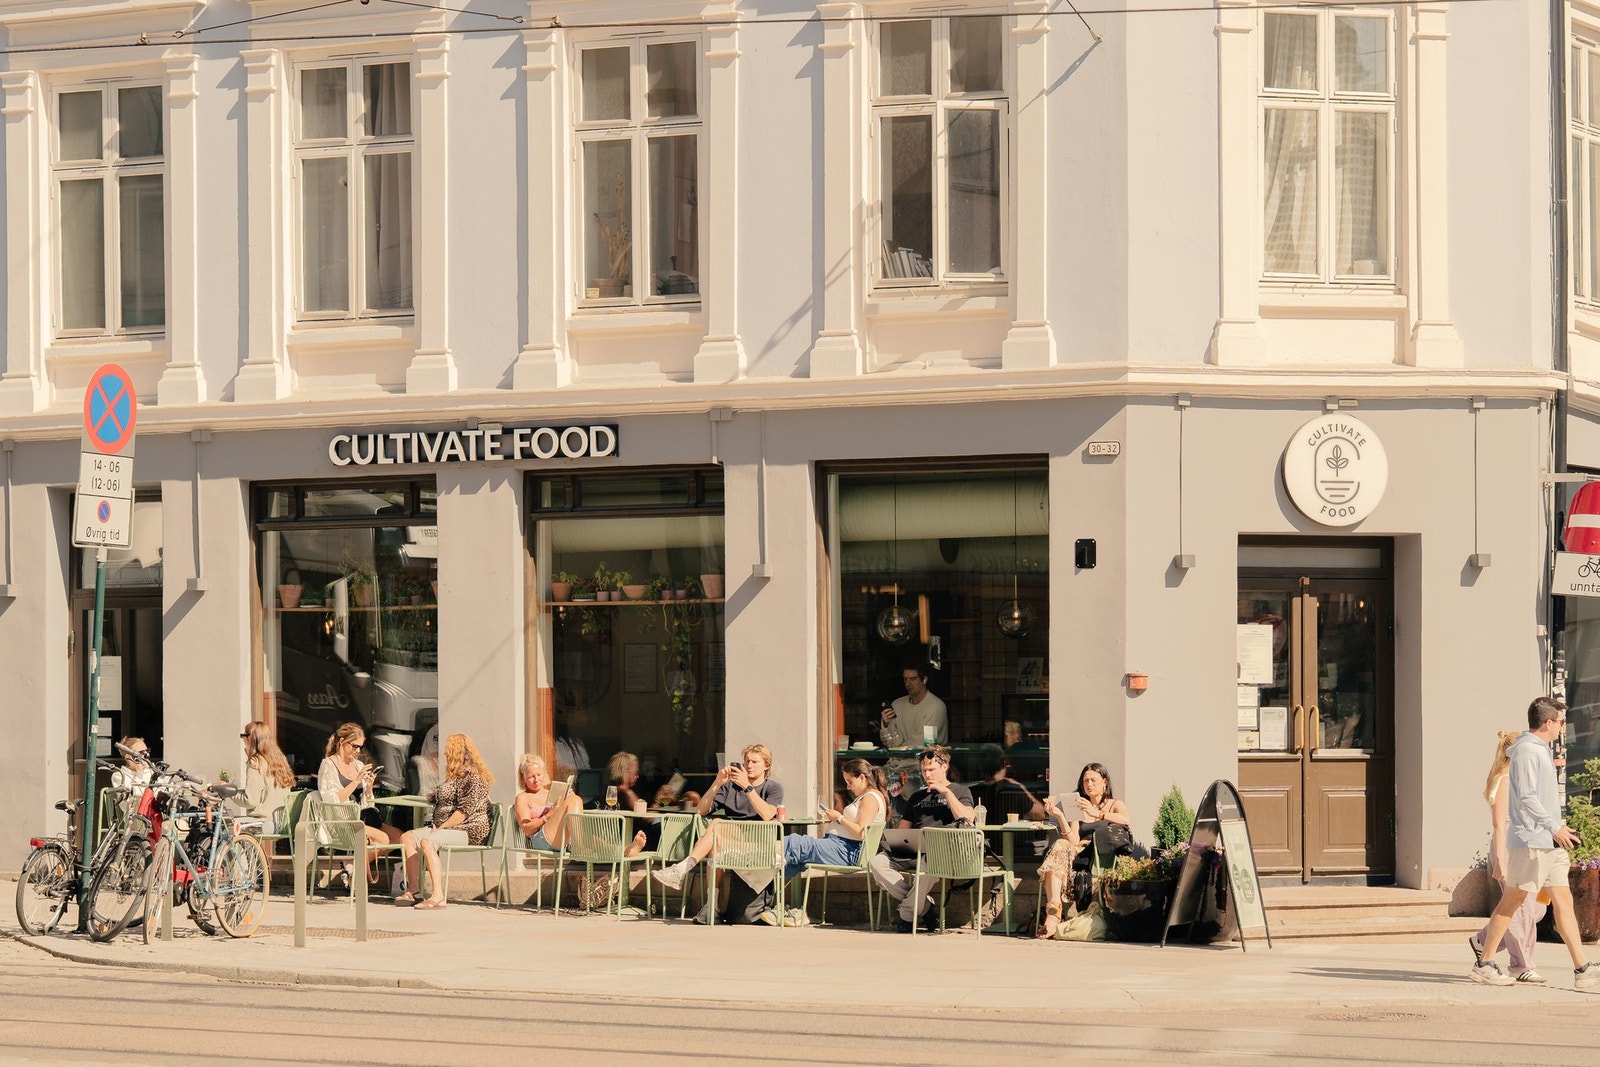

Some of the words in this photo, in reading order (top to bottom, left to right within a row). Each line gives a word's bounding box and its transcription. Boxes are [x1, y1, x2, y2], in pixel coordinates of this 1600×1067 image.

[1307, 423, 1367, 447] CULTIVATE
[328, 430, 504, 466] CULTIVATE
[513, 426, 616, 460] FOOD
[1091, 444, 1117, 454] 30-32
[1319, 505, 1356, 517] FOOD
[86, 526, 107, 542] Øvrig
[109, 529, 120, 540] tid
